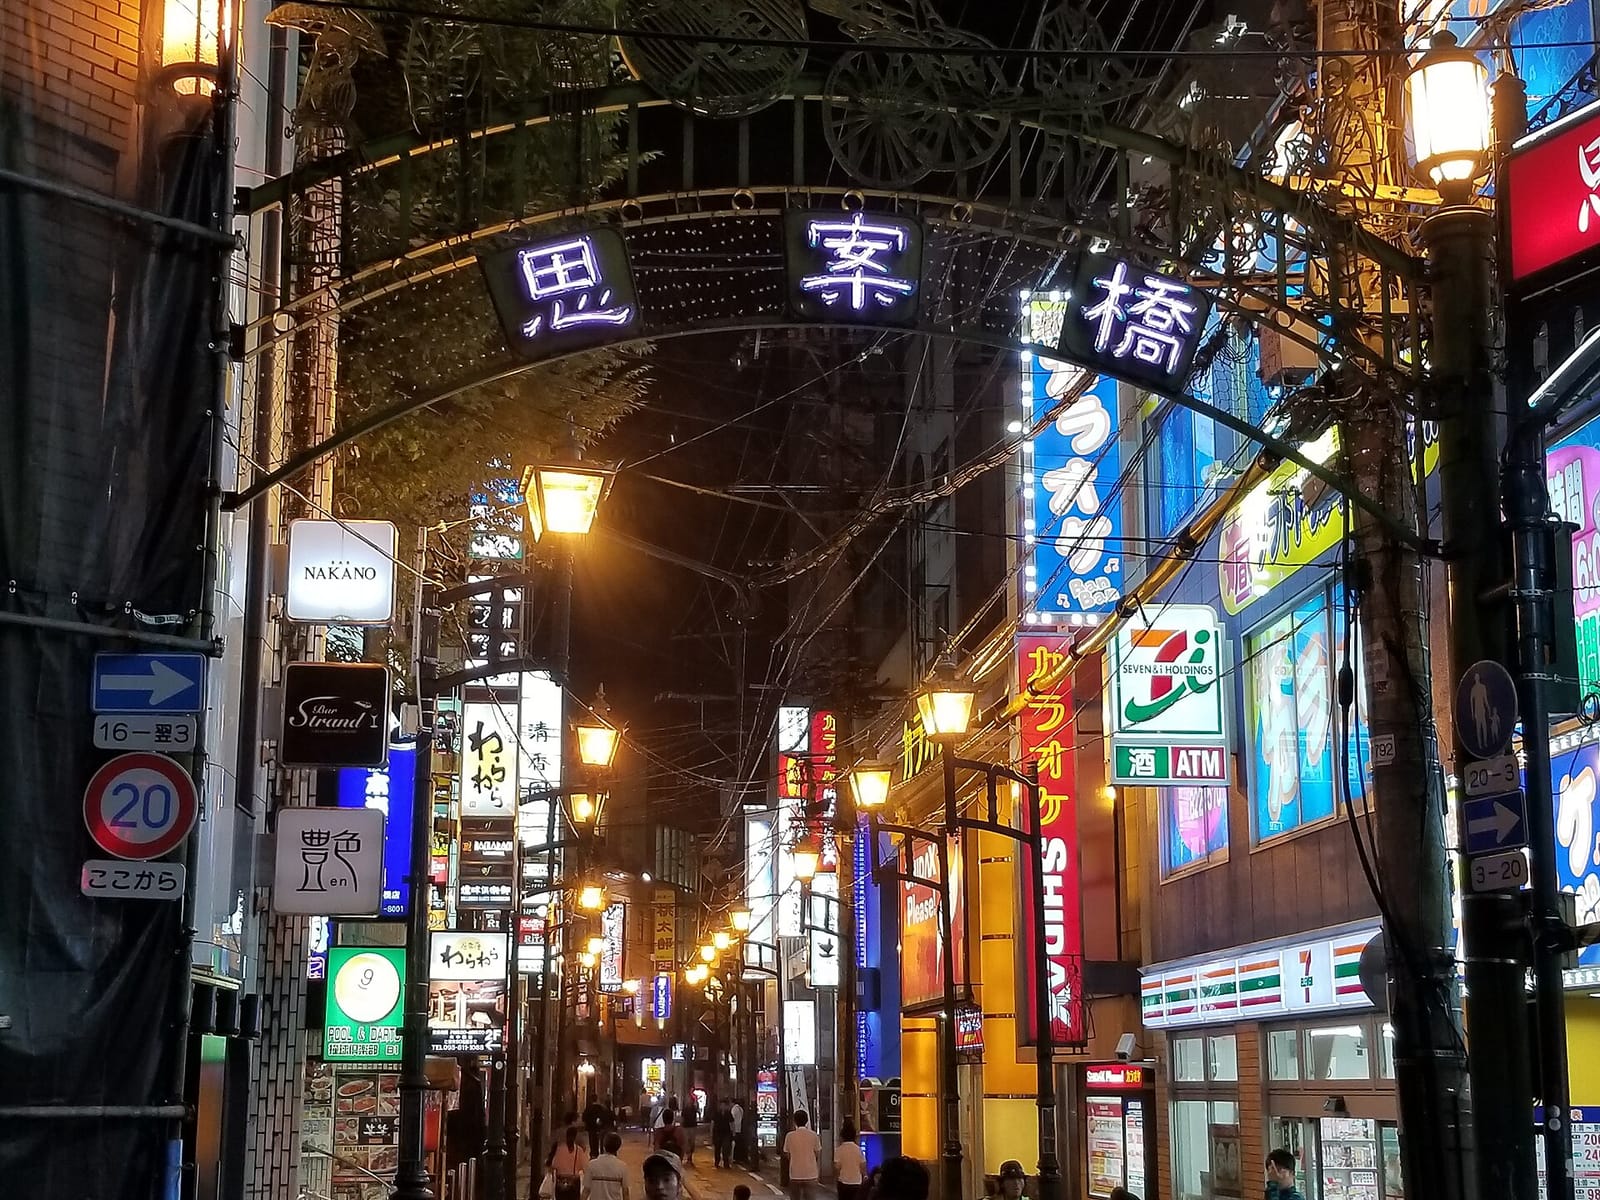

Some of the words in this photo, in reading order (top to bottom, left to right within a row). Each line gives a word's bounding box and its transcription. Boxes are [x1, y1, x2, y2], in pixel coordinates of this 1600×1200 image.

[304, 566, 377, 580] NAKANO
[1165, 664, 1213, 675] HOLDINGS
[289, 696, 366, 728] Strand
[312, 704, 338, 714] Bar
[822, 714, 838, 781] カラ
[1027, 645, 1069, 826] カラオケ
[468, 721, 506, 808] わらわら
[1129, 748, 1156, 777] 酒
[1176, 749, 1221, 777] ATM
[110, 782, 171, 829] 20
[88, 869, 177, 891] ここから
[330, 878, 347, 887] en
[907, 888, 937, 928] Please!
[440, 944, 499, 969] わらわら
[327, 1027, 353, 1041] POOL
[358, 1026, 366, 1040] &
[485, 1029, 502, 1041] 2F
